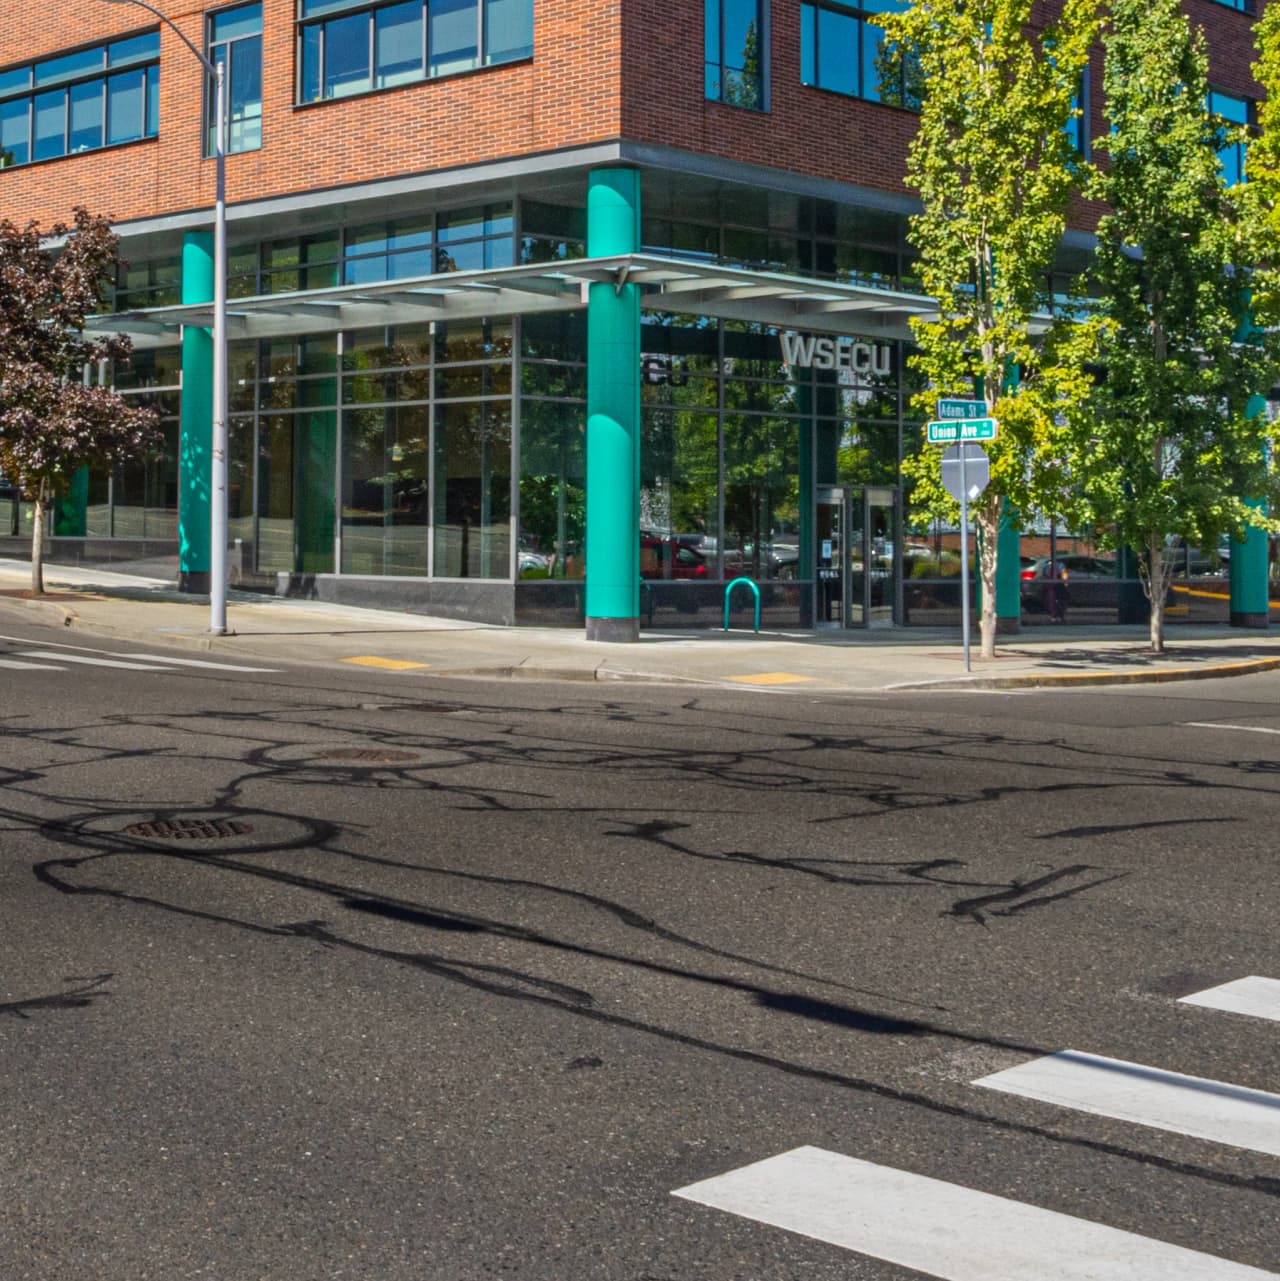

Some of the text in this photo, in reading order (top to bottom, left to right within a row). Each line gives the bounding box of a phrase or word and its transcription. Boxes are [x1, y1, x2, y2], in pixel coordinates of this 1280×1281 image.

[779, 333, 891, 376] WSECU
[941, 403, 965, 417] Adams
[968, 404, 977, 417] St
[931, 424, 957, 439] Union
[960, 423, 977, 438] Ave
